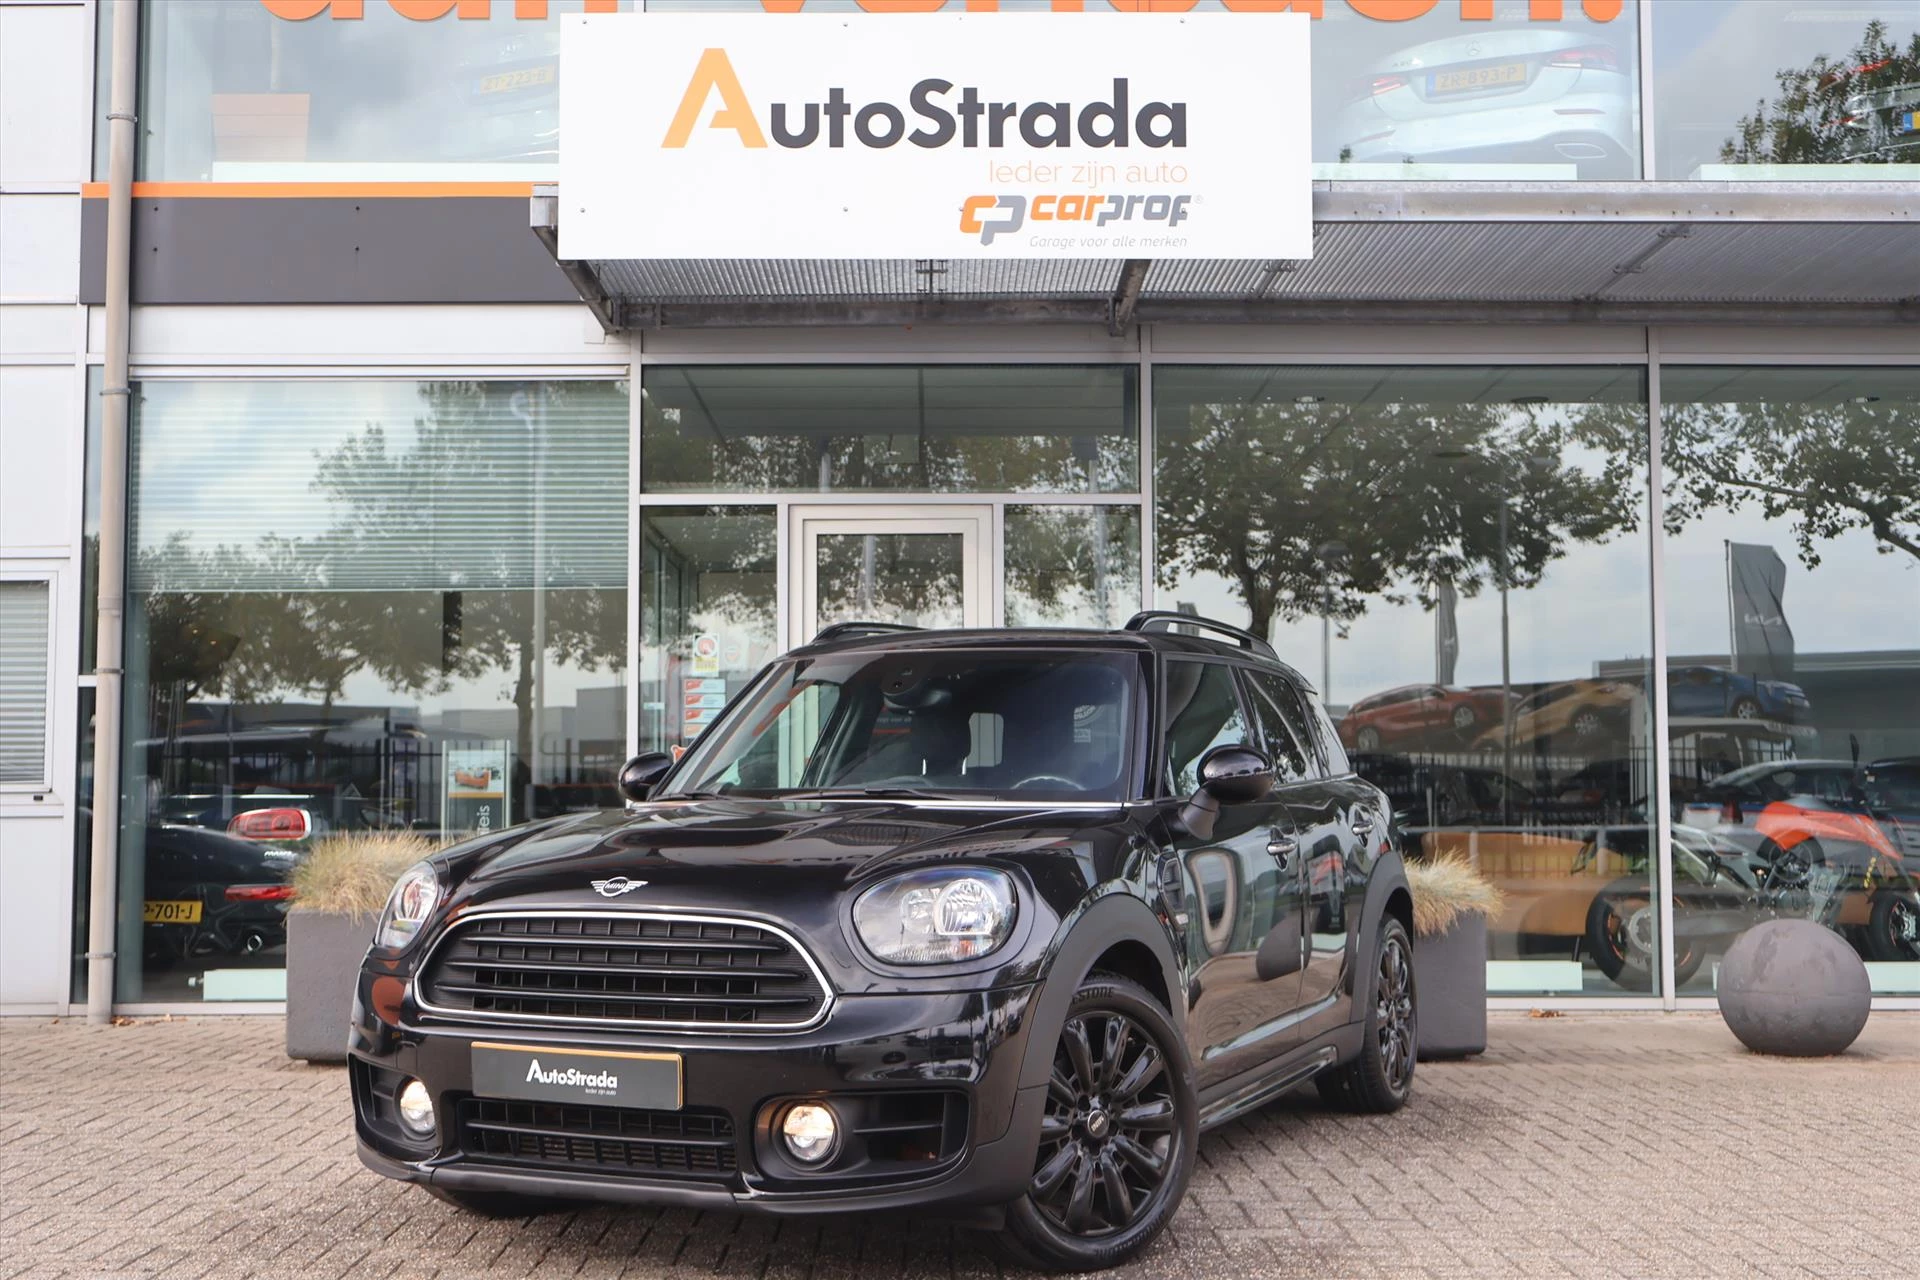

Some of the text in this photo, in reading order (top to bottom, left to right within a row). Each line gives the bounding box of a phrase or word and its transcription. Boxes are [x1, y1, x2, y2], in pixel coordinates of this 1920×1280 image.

[661, 48, 1188, 149] AutoStrada
[1072, 161, 1115, 189] zijn
[1125, 162, 1188, 183] auto
[1030, 236, 1188, 249] Garage voor alle merken
[144, 904, 192, 919] P-701-J
[525, 1059, 617, 1089] AutoStrada
